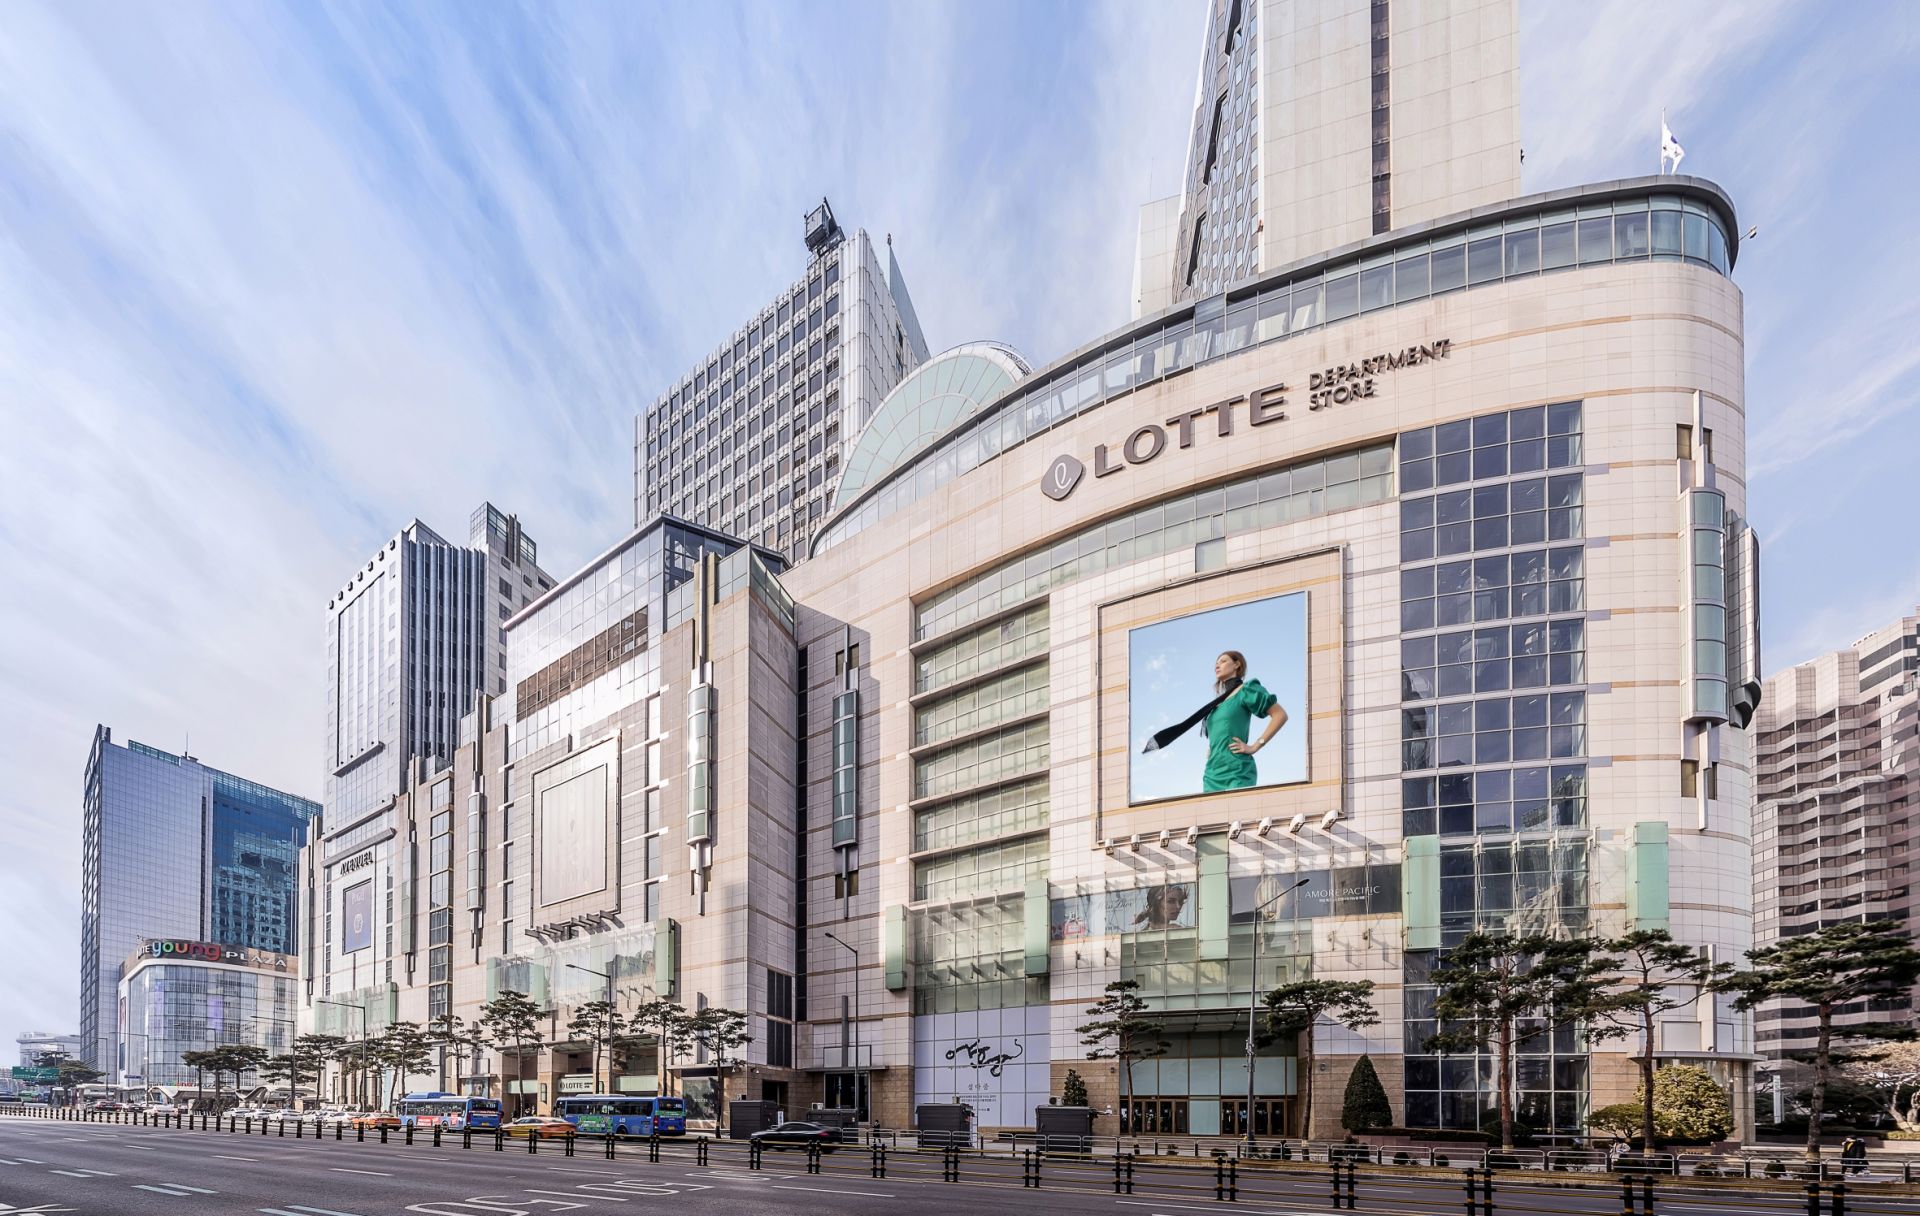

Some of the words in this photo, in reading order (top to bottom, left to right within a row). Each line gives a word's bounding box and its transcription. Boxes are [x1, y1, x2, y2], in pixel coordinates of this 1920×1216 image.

[1309, 337, 1450, 389] DEPARTMENT
[1309, 378, 1376, 411] STORE
[1094, 381, 1286, 478] LOTTE
[340, 850, 374, 875] AVENUEL
[1304, 888, 1341, 899] AMORE
[152, 940, 222, 961] young
[225, 950, 287, 967] PLAZA
[565, 1081, 583, 1089] LOTTE
